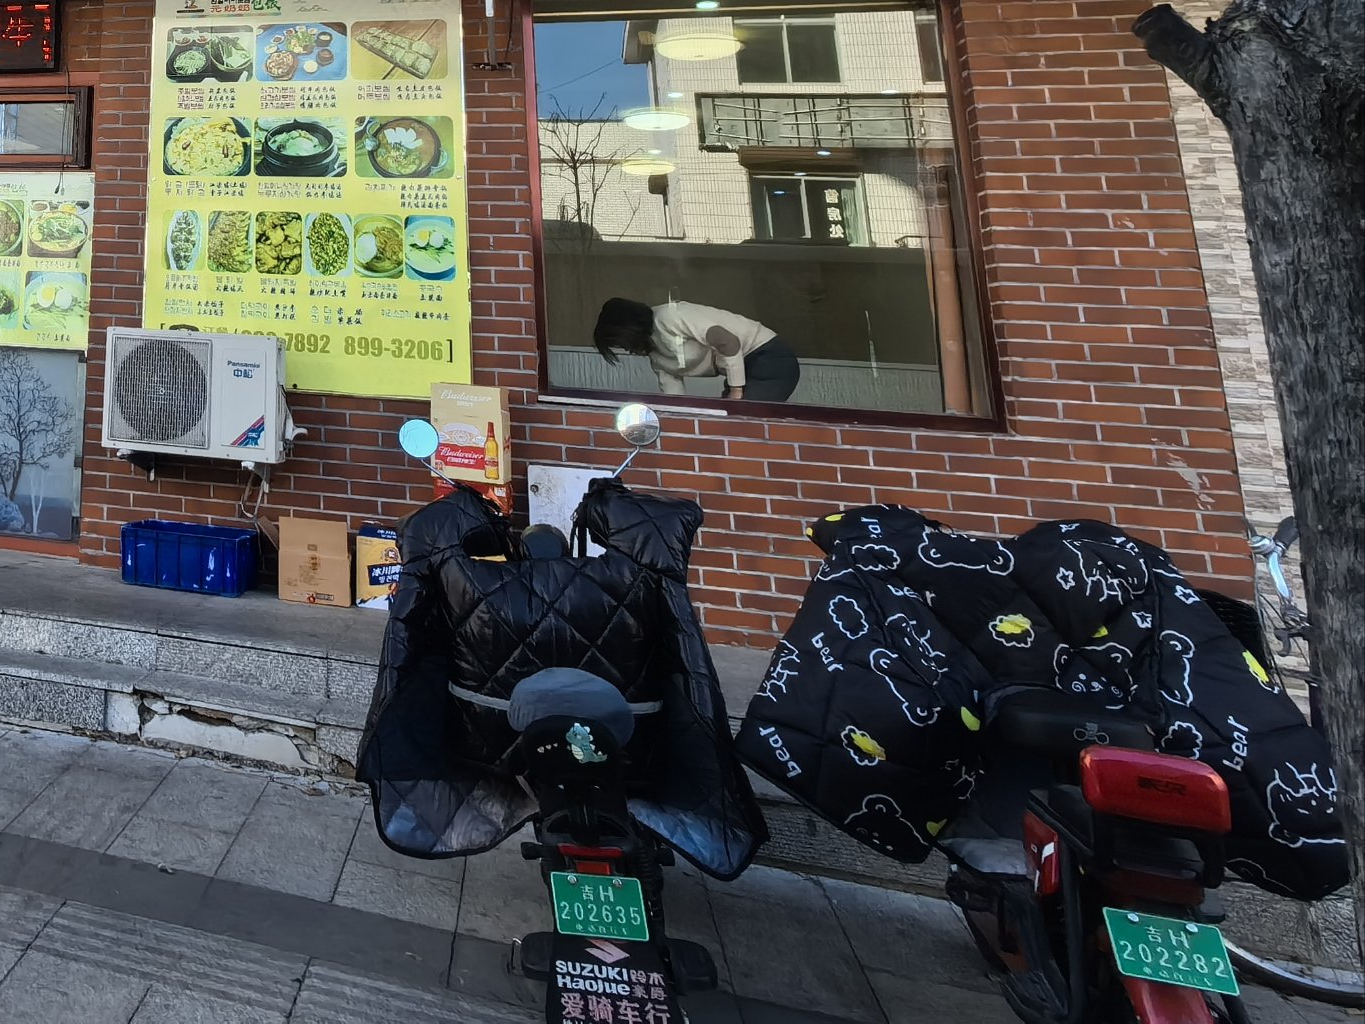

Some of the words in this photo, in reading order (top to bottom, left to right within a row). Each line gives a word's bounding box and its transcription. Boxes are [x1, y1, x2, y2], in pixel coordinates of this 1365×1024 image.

[439, 446, 484, 459] Budweiser
[811, 632, 844, 672] bear
[758, 726, 802, 778] bear
[1223, 716, 1251, 772] bear
[560, 901, 641, 925] 202635
[556, 960, 629, 982] SUZUKI
[630, 969, 665, 986] 铃木
[1120, 941, 1230, 978] 202282
[560, 992, 671, 1024] 爱骑车行
